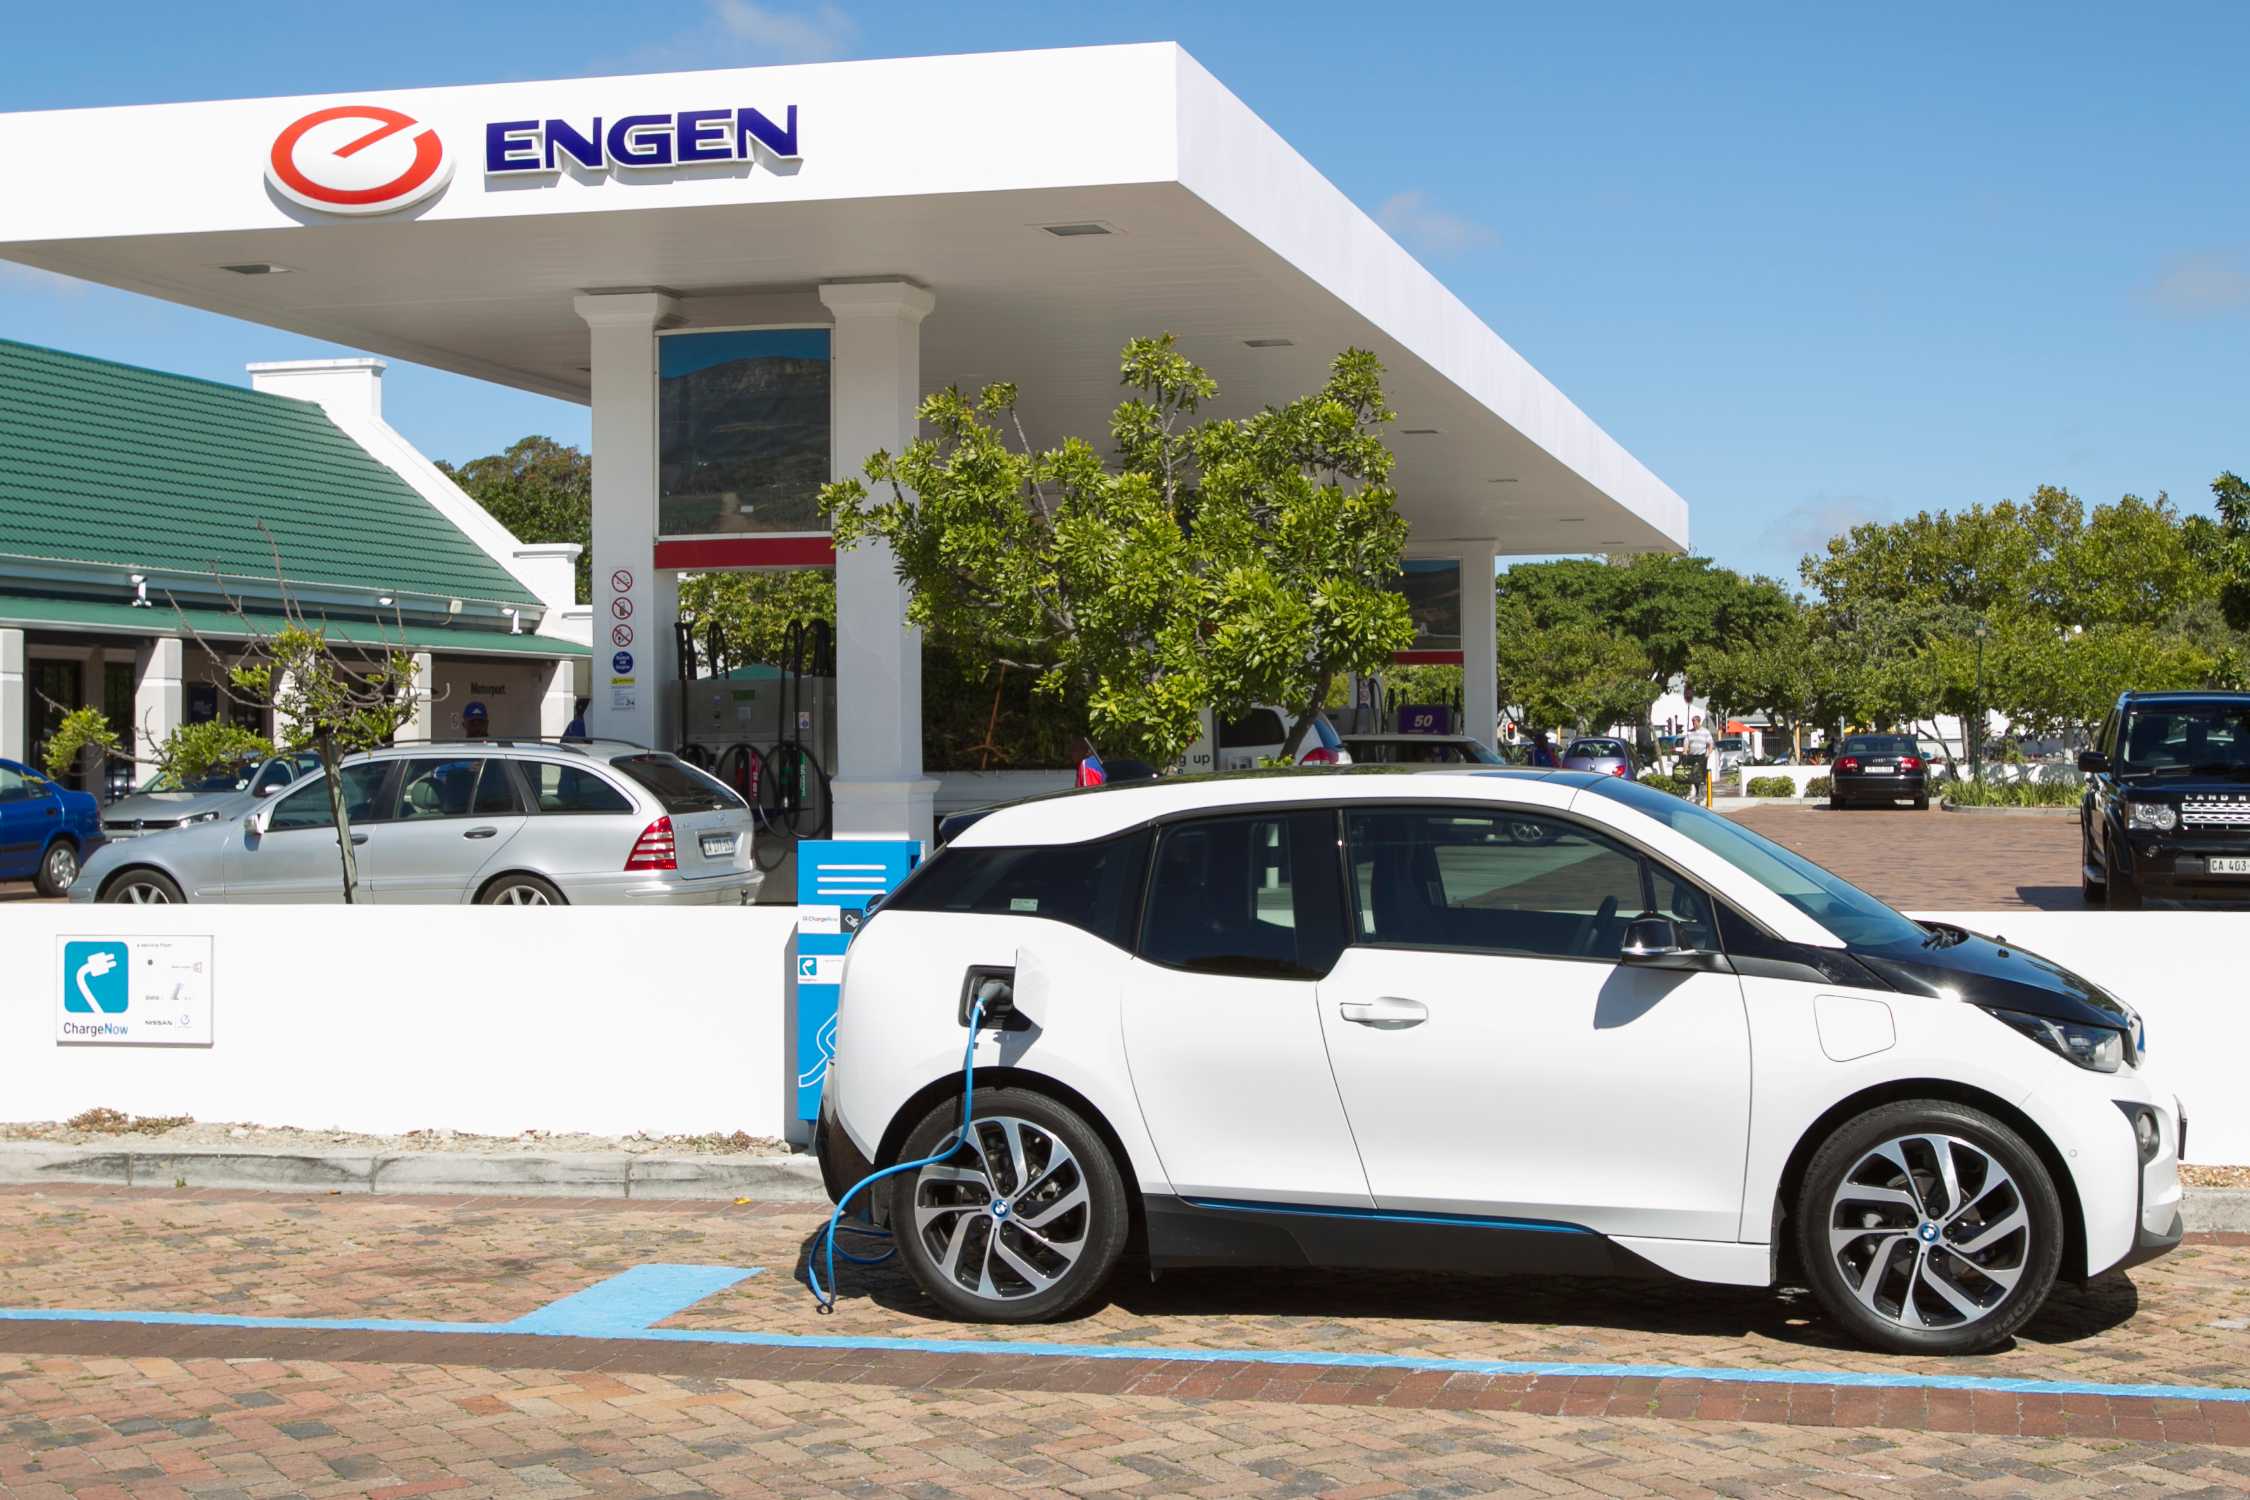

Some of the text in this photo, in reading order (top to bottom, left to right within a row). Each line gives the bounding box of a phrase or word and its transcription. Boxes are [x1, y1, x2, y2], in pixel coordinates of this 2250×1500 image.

[486, 104, 799, 173] ENGEN
[1414, 714, 1434, 728] 50
[1193, 754, 1210, 767] up
[2212, 860, 2224, 871] CA
[63, 1022, 128, 1037] ChargeNow
